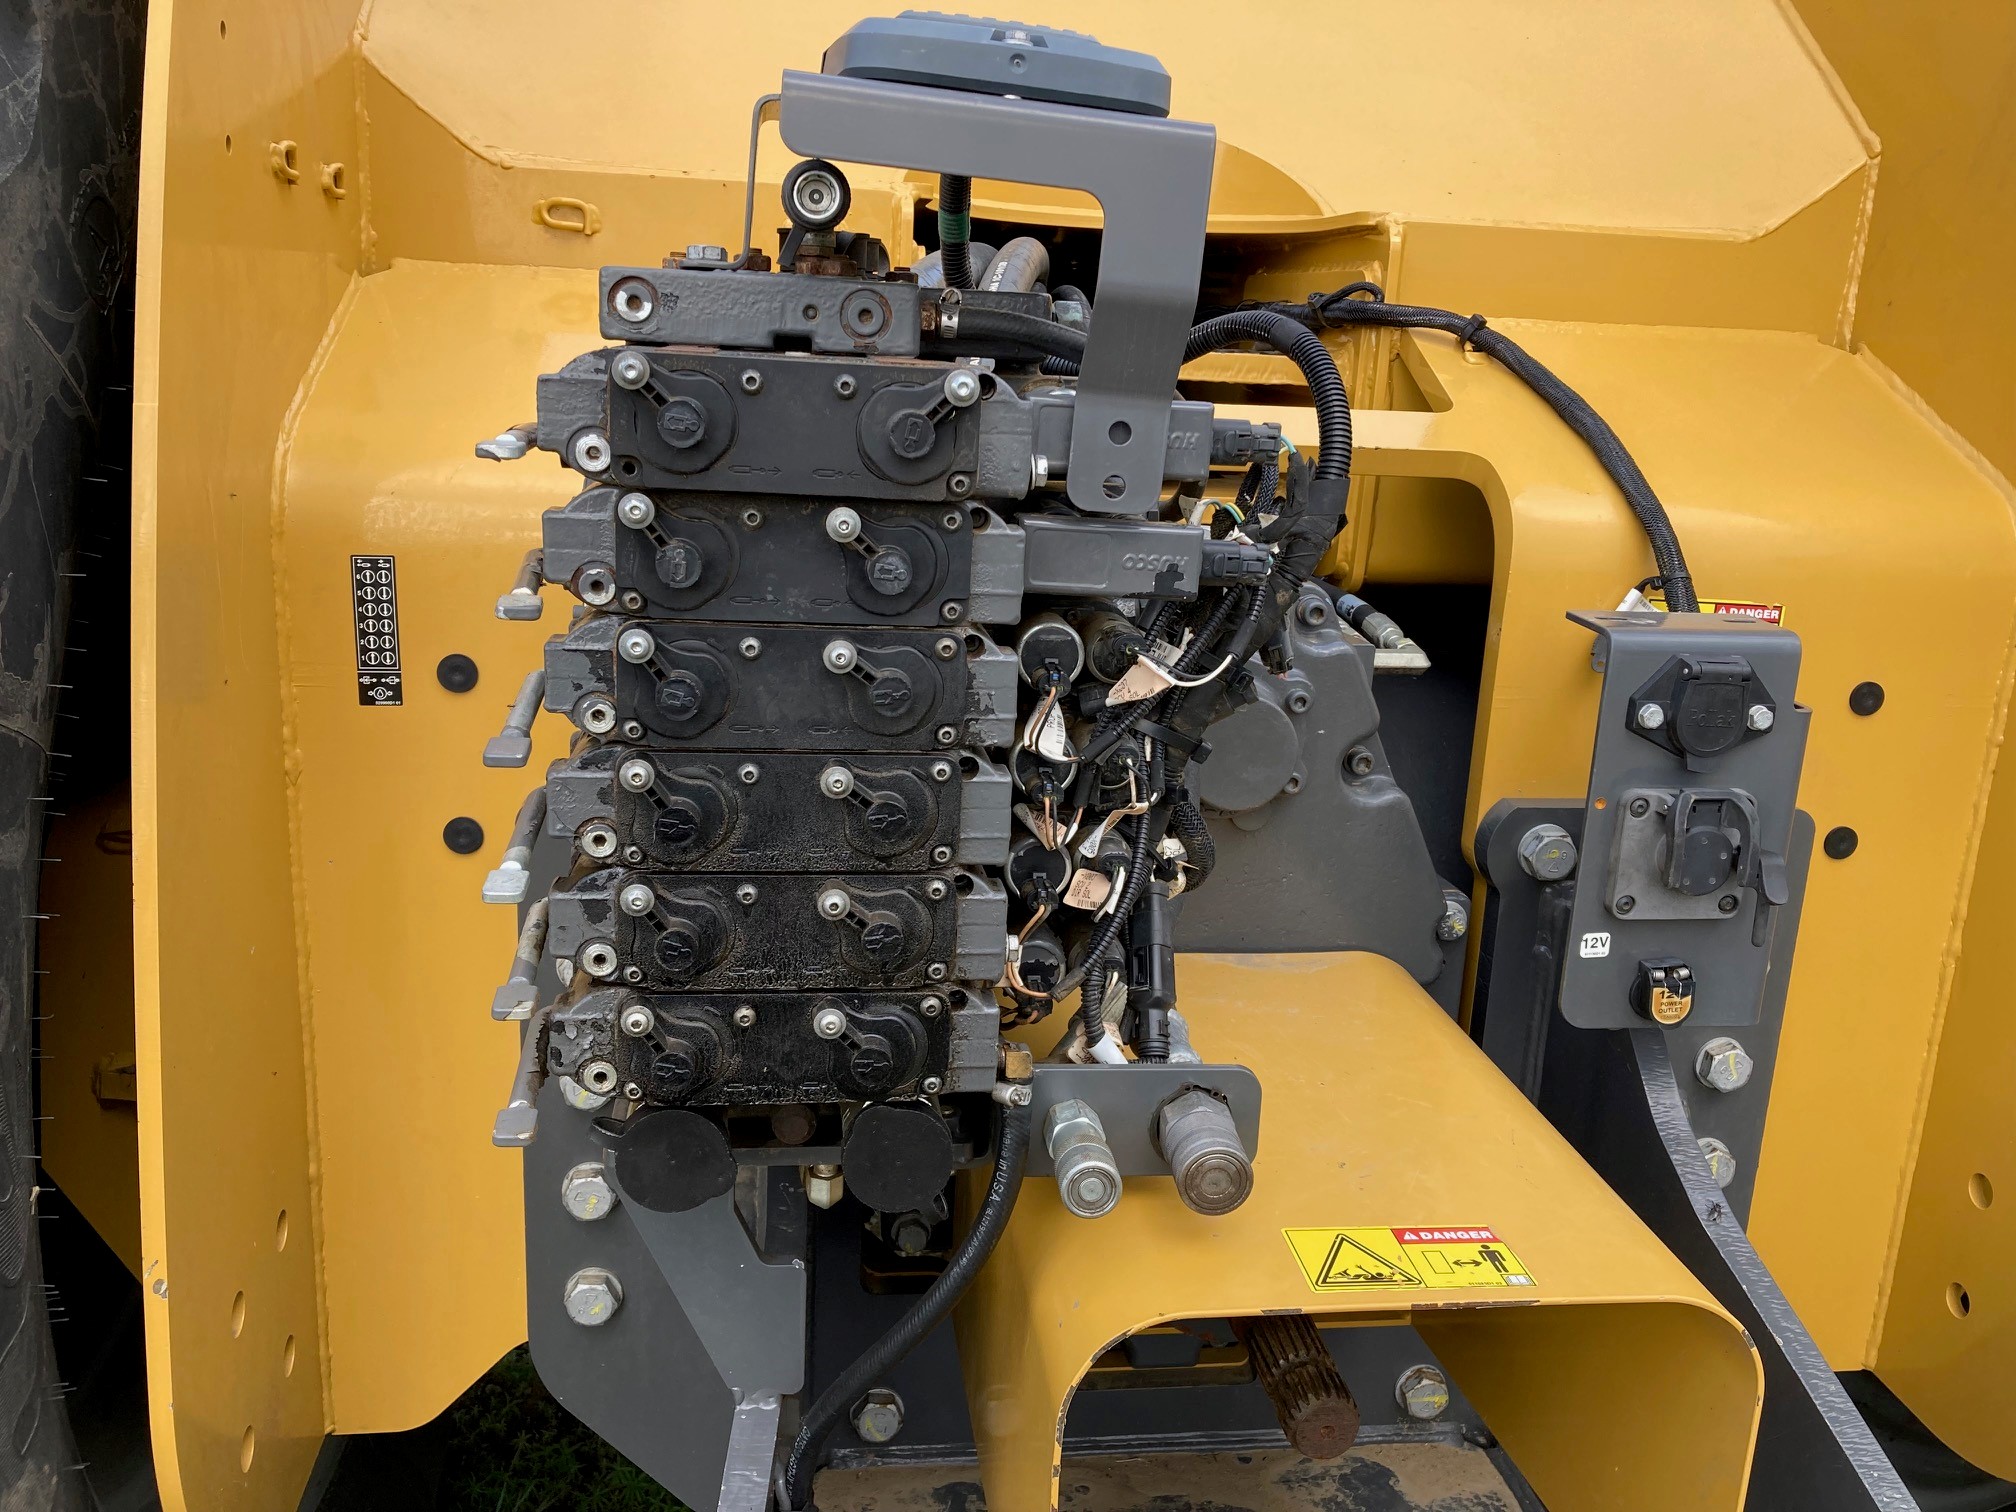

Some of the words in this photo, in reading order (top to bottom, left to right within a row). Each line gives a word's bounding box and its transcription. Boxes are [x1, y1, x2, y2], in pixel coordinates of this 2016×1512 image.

[1730, 607, 1779, 619] DANGER
[1582, 936, 1609, 949] 12V
[997, 1158, 1009, 1170] in
[988, 1171, 1007, 1202] U.S.A.
[1418, 1231, 1493, 1240] DANGER
